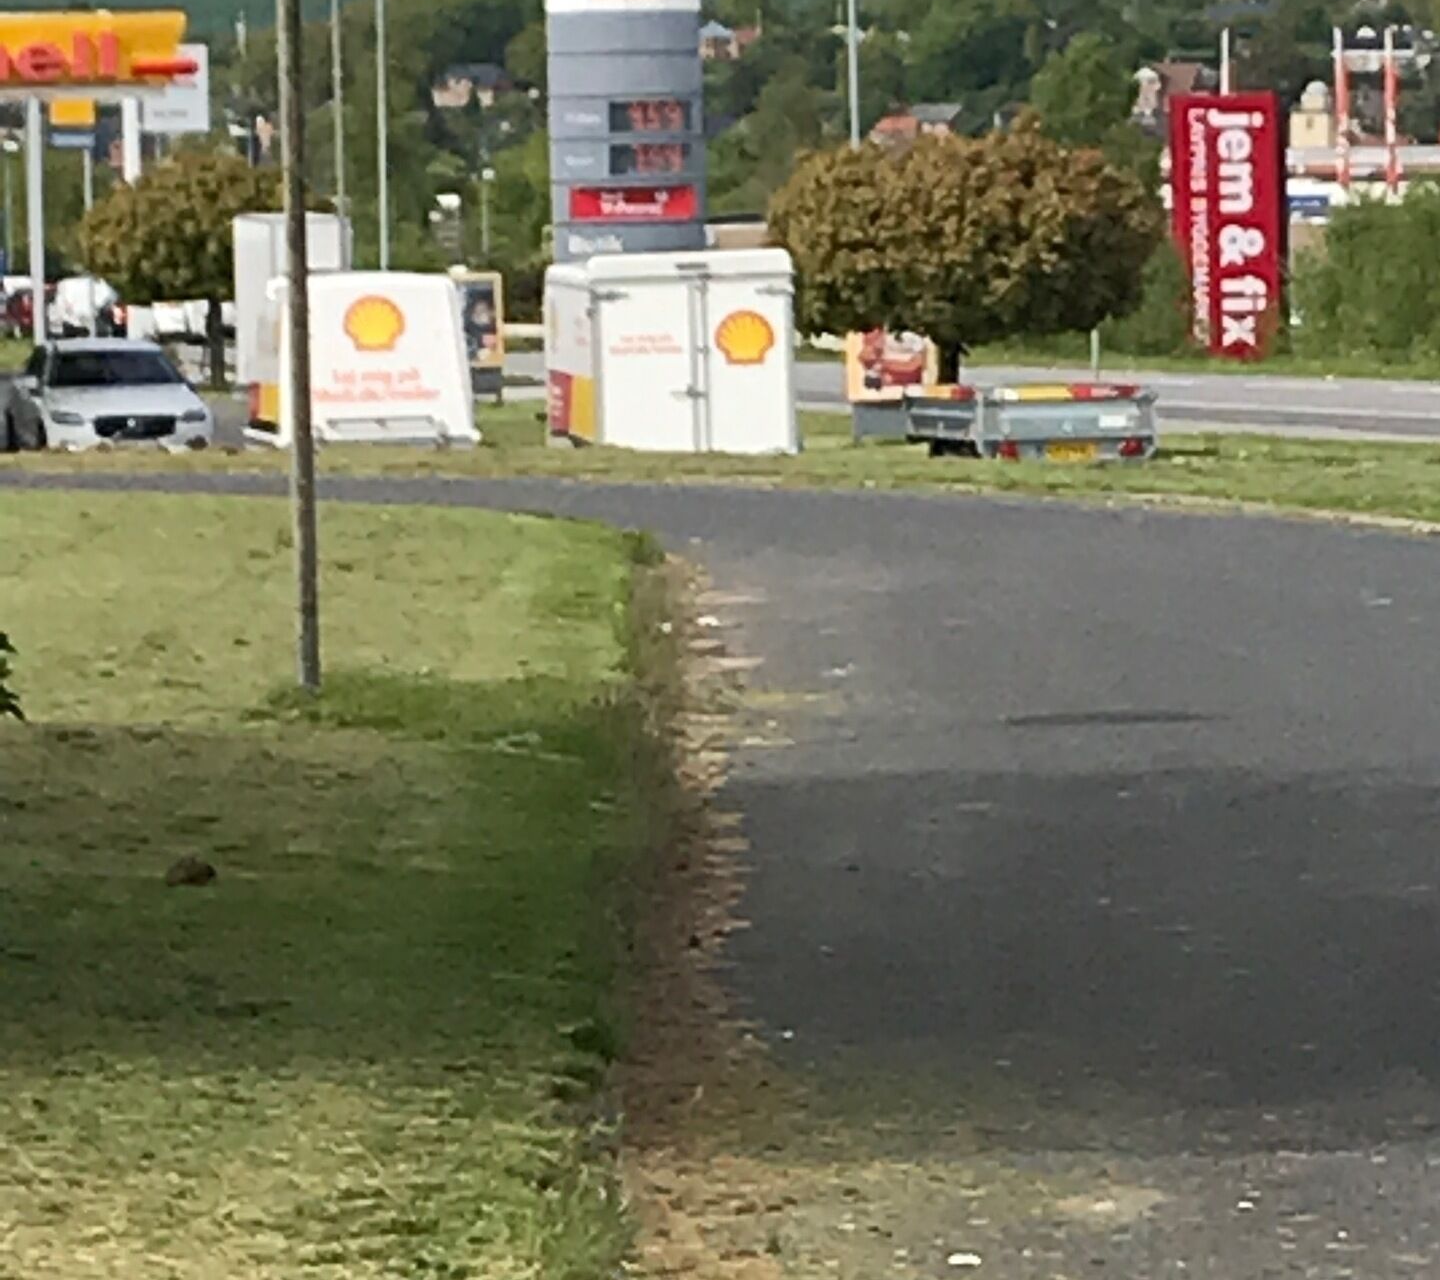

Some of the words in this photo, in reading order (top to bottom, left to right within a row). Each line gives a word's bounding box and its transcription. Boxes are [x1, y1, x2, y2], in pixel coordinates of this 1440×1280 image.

[1207, 108, 1264, 213] jem
[1219, 224, 1265, 269] &
[1220, 275, 1267, 347] fix
